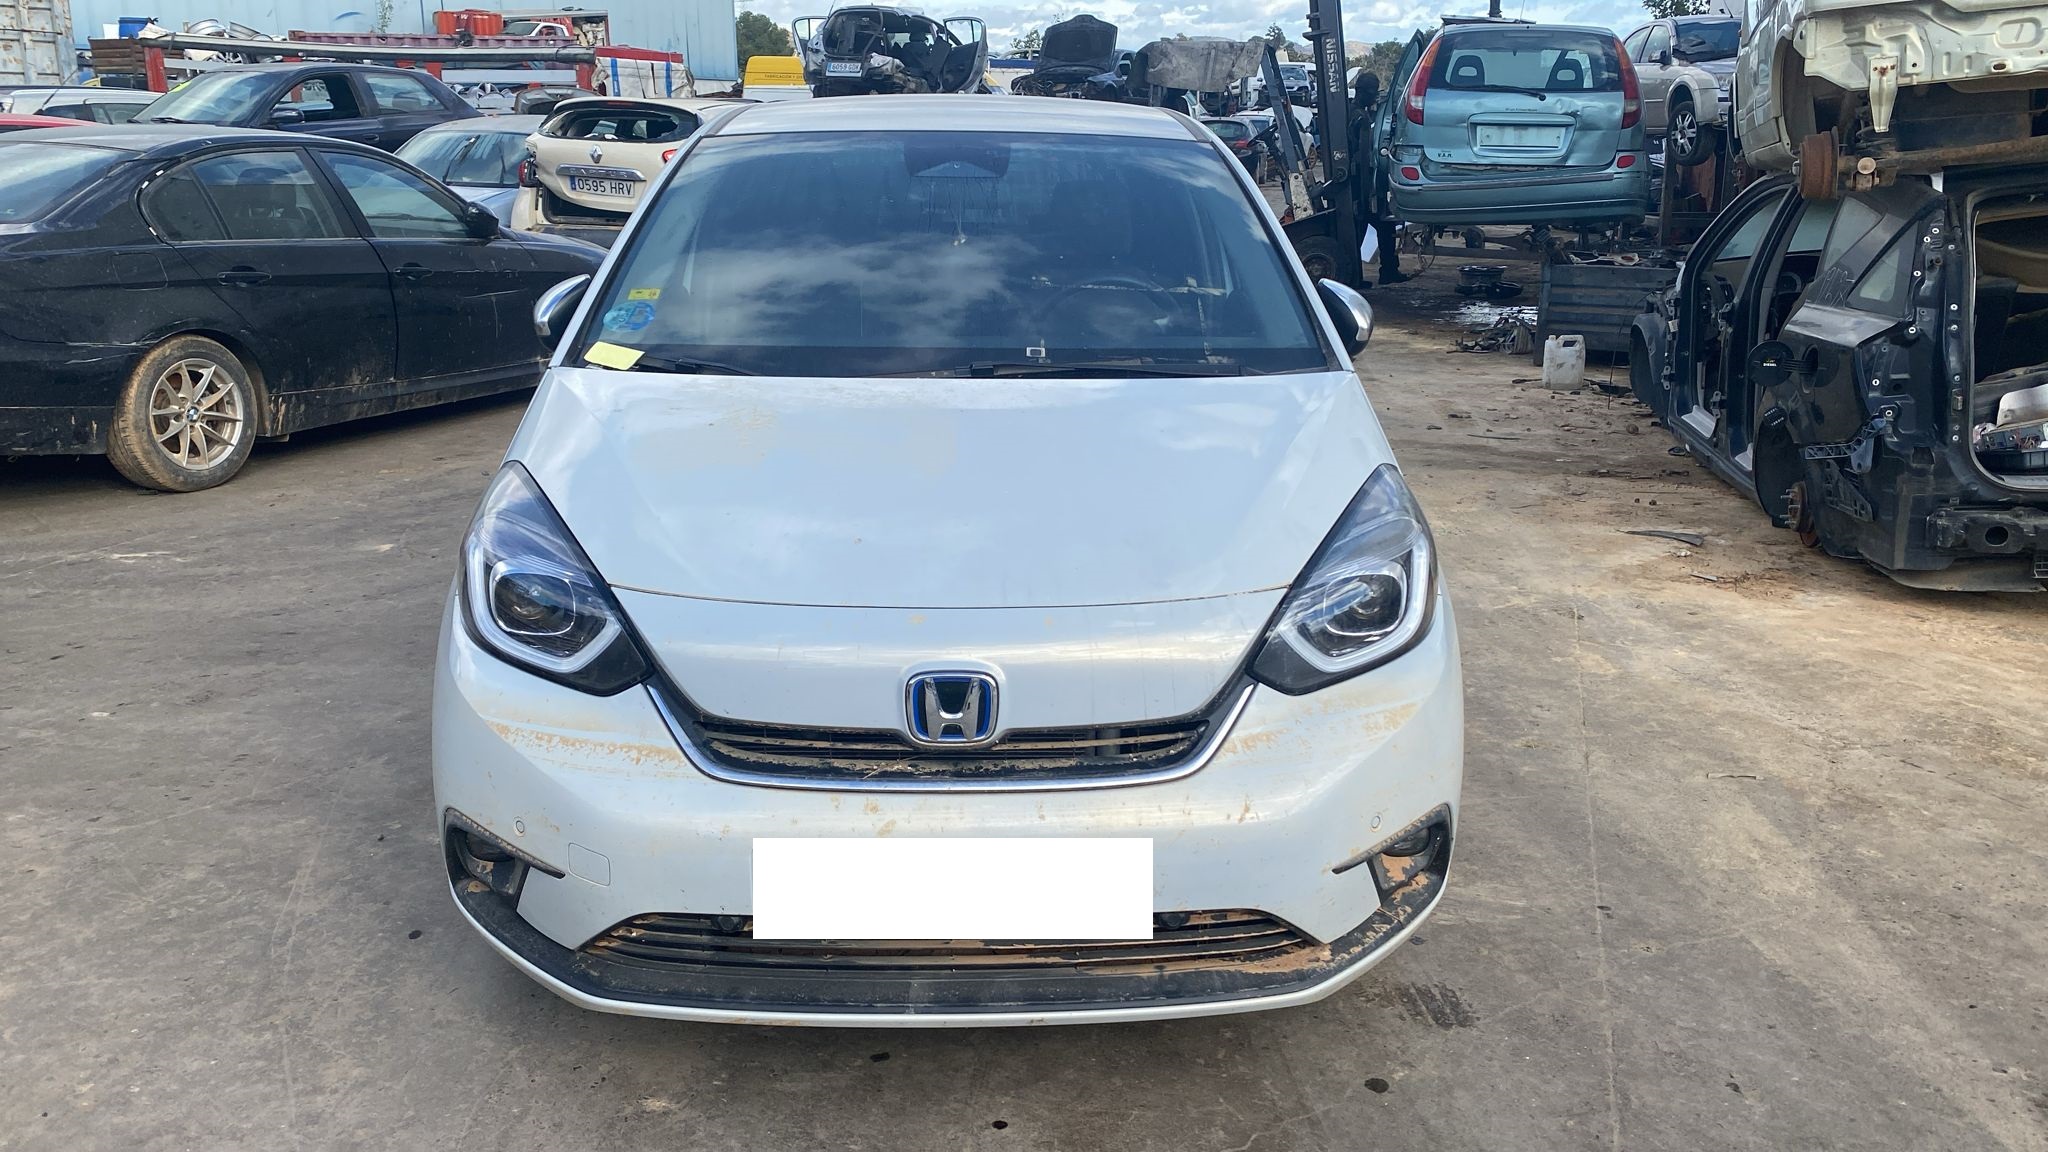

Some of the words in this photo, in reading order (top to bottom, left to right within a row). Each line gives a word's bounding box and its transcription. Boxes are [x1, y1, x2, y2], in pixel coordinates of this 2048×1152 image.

[831, 63, 848, 71] 6059
[1326, 38, 1340, 93] NISSAN
[577, 178, 606, 193] 0595
[610, 182, 632, 196] HRV
